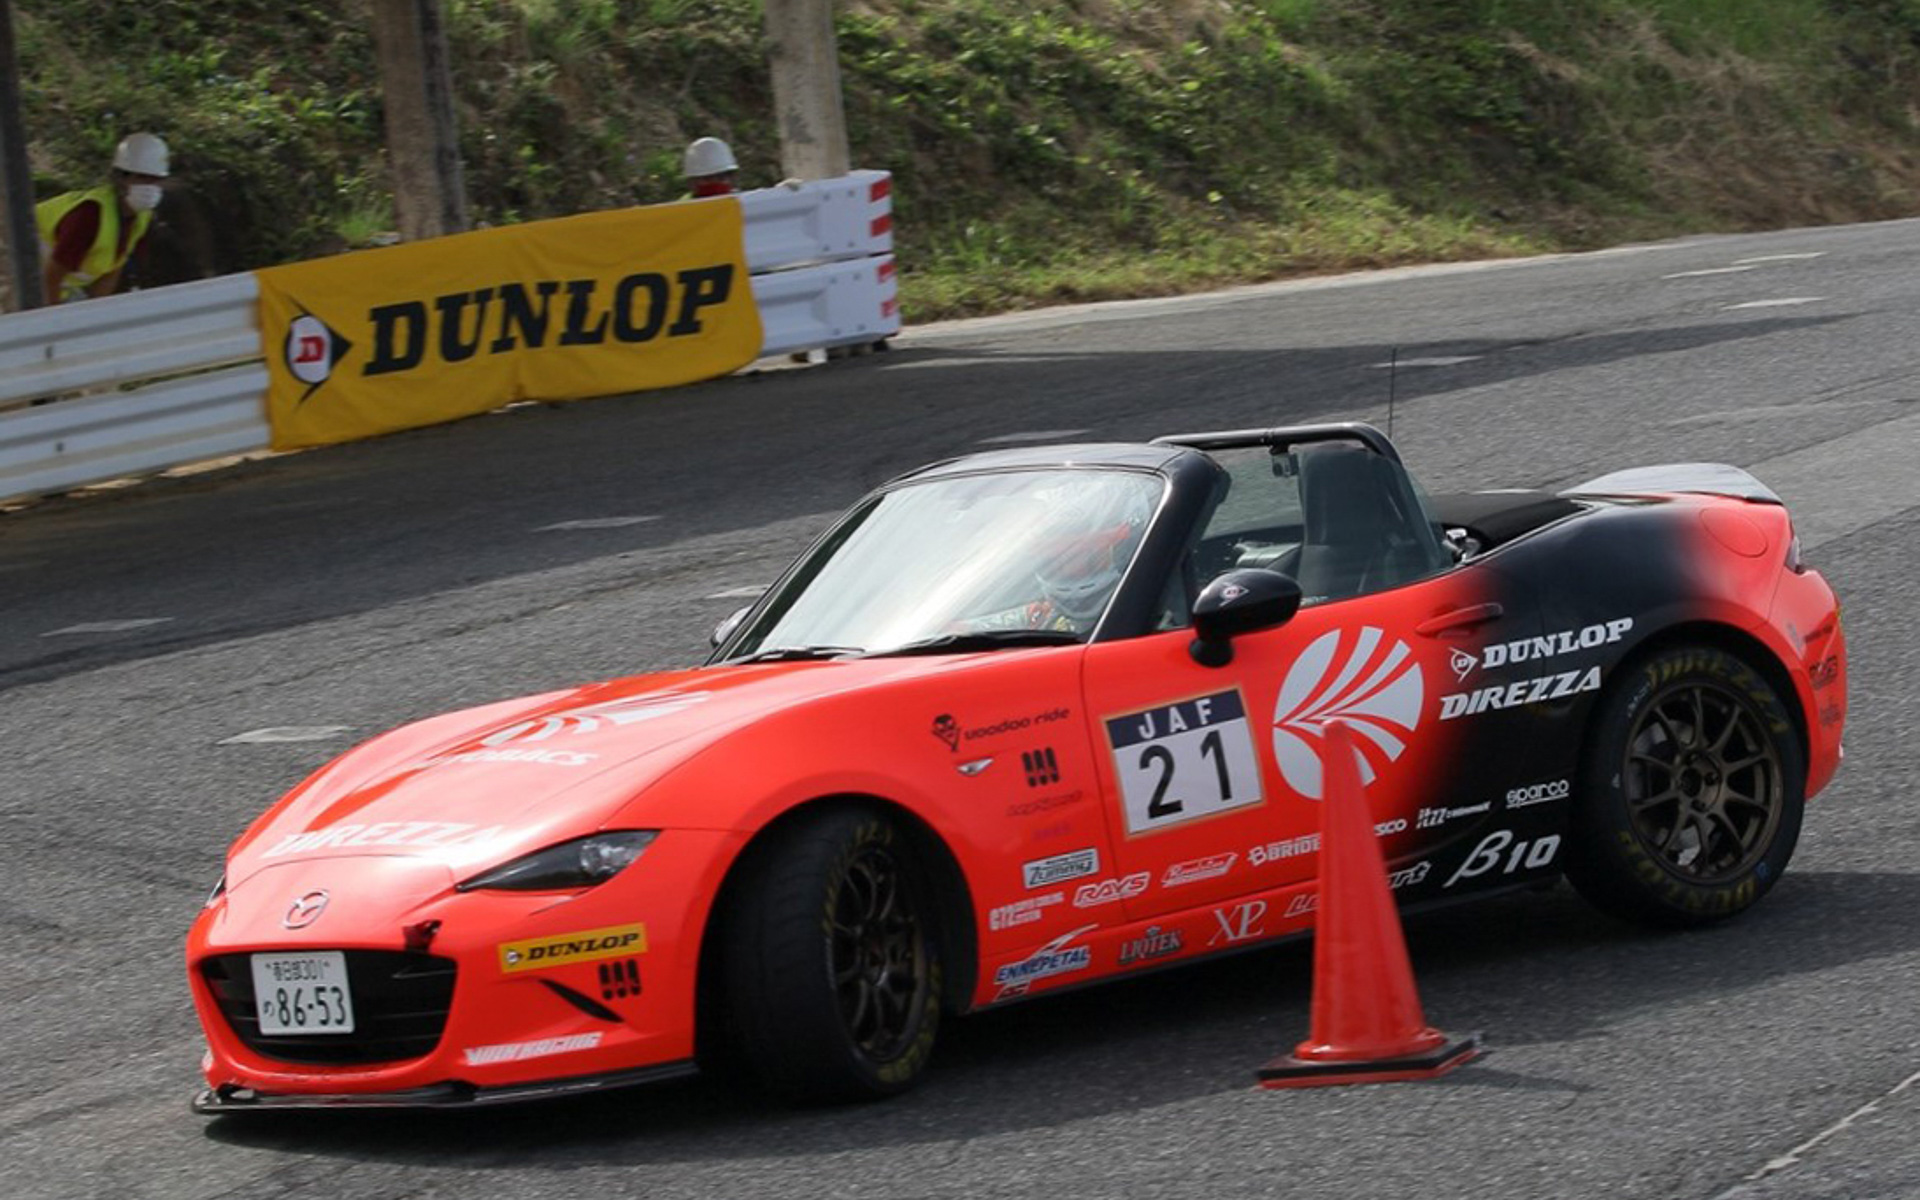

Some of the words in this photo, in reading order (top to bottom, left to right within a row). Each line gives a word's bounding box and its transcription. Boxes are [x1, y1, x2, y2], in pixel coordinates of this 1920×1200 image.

[362, 264, 735, 377] DUNLOP
[1482, 617, 1634, 669] DUNLOP
[1439, 665, 1601, 720] DIREZZA
[1034, 707, 1070, 724] ride
[1138, 698, 1212, 739] JAF
[1139, 729, 1232, 820] 21
[1506, 778, 1571, 808] sparco
[1074, 872, 1150, 908] RAYS
[527, 933, 640, 961] DUNLOP
[996, 948, 1087, 982] ENNEPETAL
